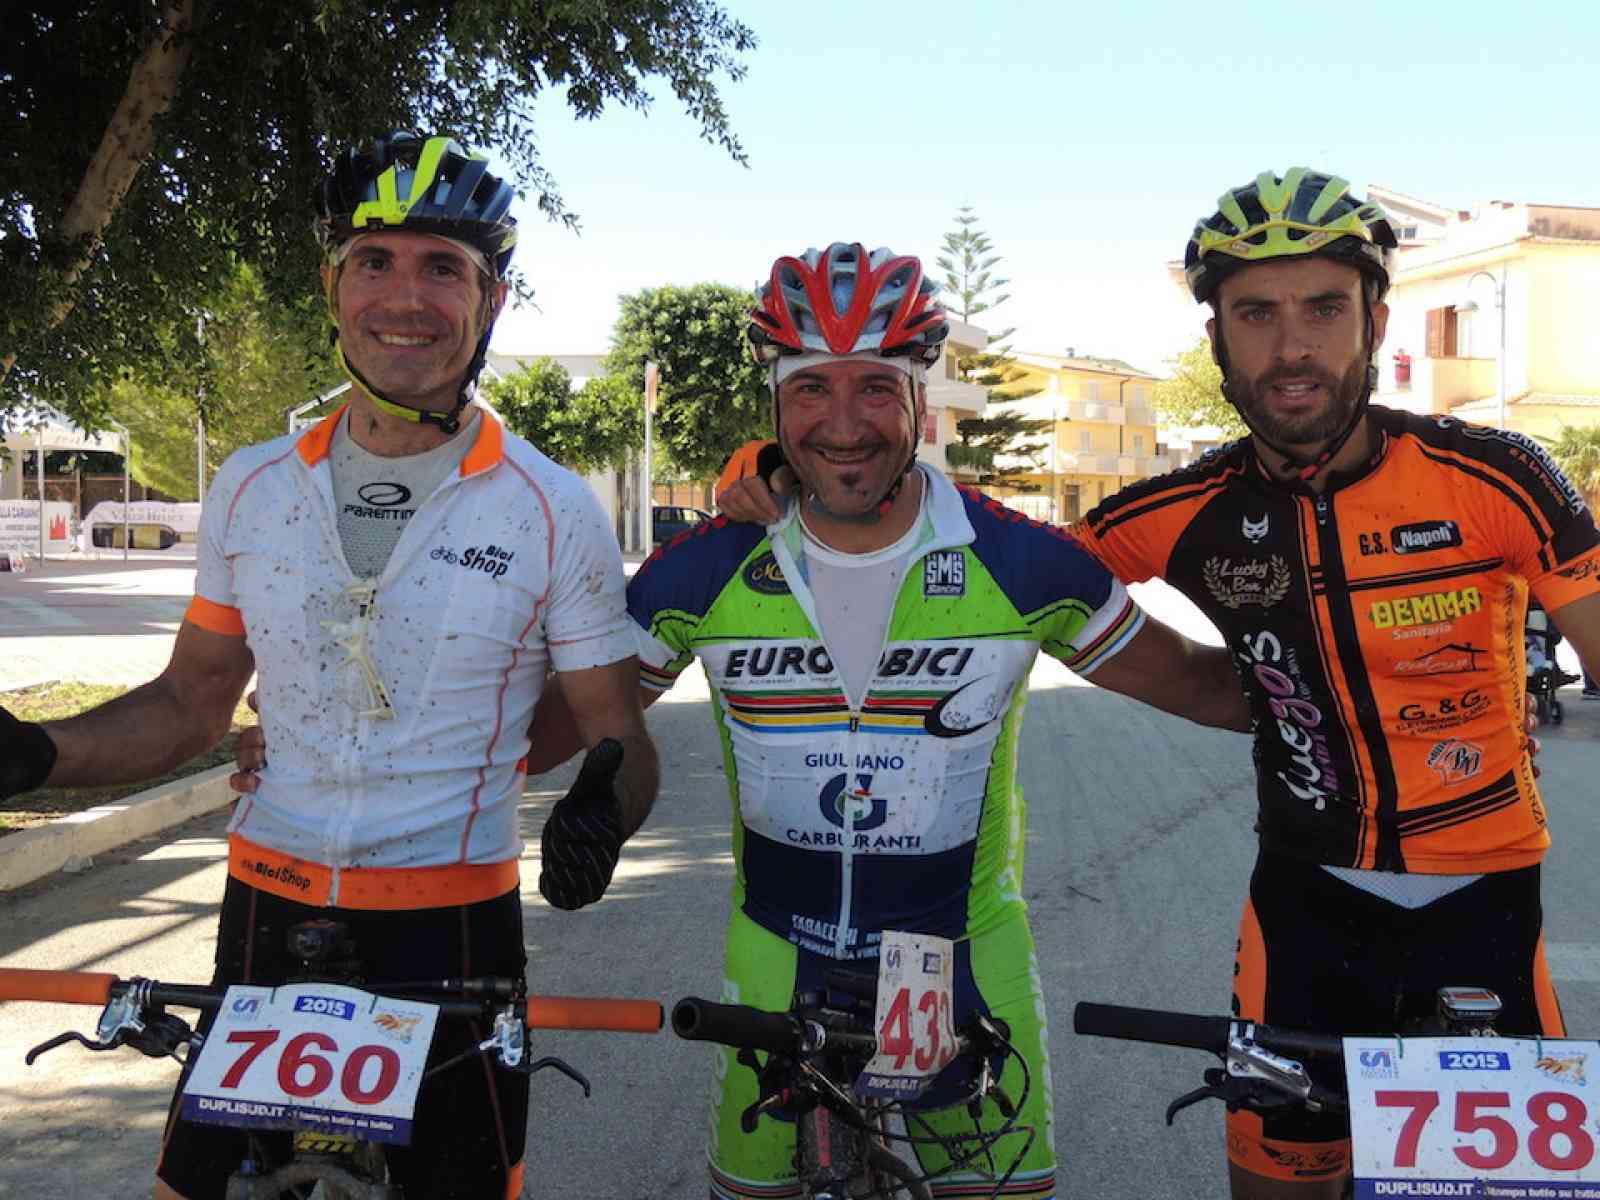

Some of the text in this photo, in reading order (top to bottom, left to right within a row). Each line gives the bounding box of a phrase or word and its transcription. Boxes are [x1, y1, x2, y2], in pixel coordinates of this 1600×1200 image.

[1359, 526, 1452, 556] G.S. Napoli
[459, 548, 508, 579] Shop
[925, 551, 964, 586] SMS
[805, 753, 905, 770] GIULIANO
[786, 829, 921, 849] CARBURANTI
[301, 998, 347, 1015] 2015
[219, 1030, 401, 1105] 760
[1447, 1054, 1501, 1069] 2015
[199, 1097, 286, 1117] DUPLISUD.IT
[1374, 1090, 1595, 1171] 758
[1375, 1182, 1475, 1196] DUPLISUD.IT
